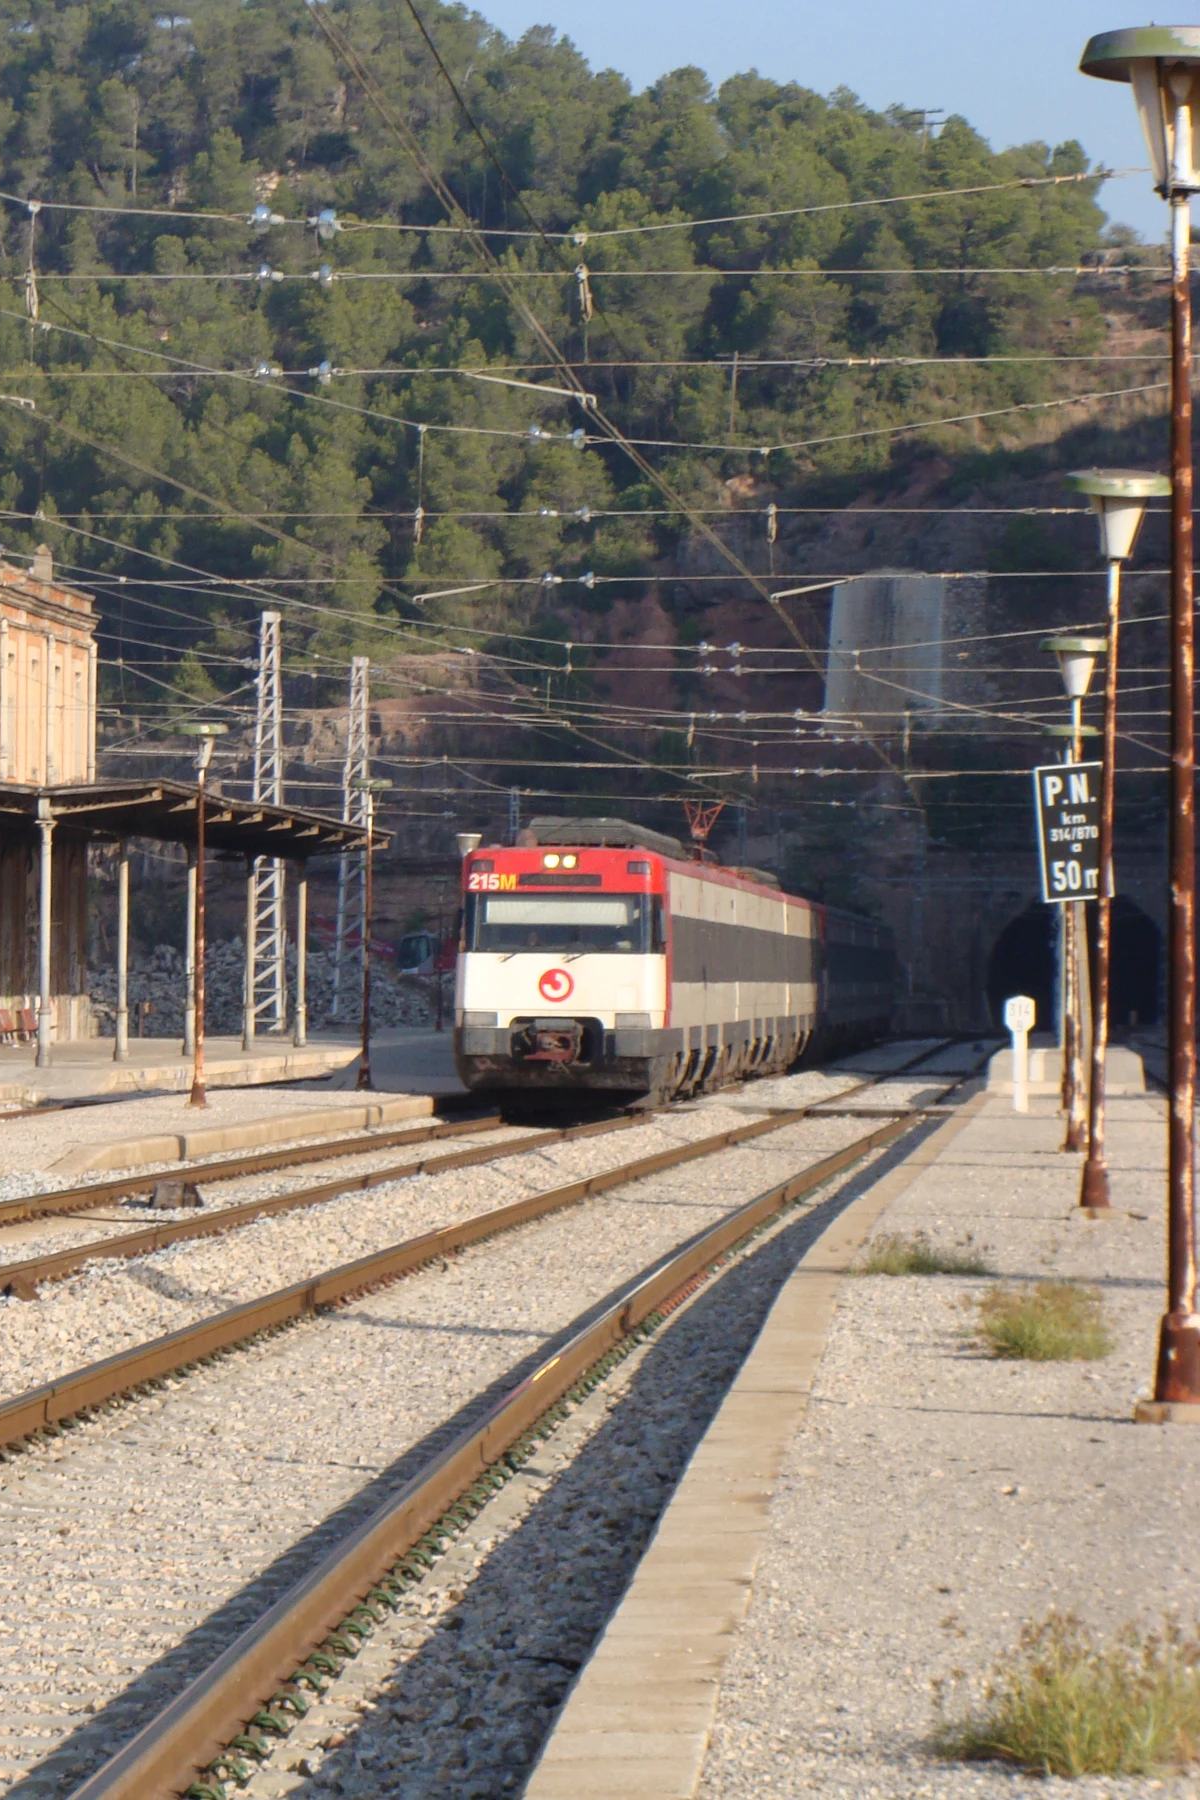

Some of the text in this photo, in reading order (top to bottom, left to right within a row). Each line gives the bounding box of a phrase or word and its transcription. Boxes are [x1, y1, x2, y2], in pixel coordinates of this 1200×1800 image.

[1044, 772, 1097, 807] P.N.
[1060, 811, 1087, 825] km
[1050, 825, 1099, 842] 314/870
[468, 872, 516, 890] 215M
